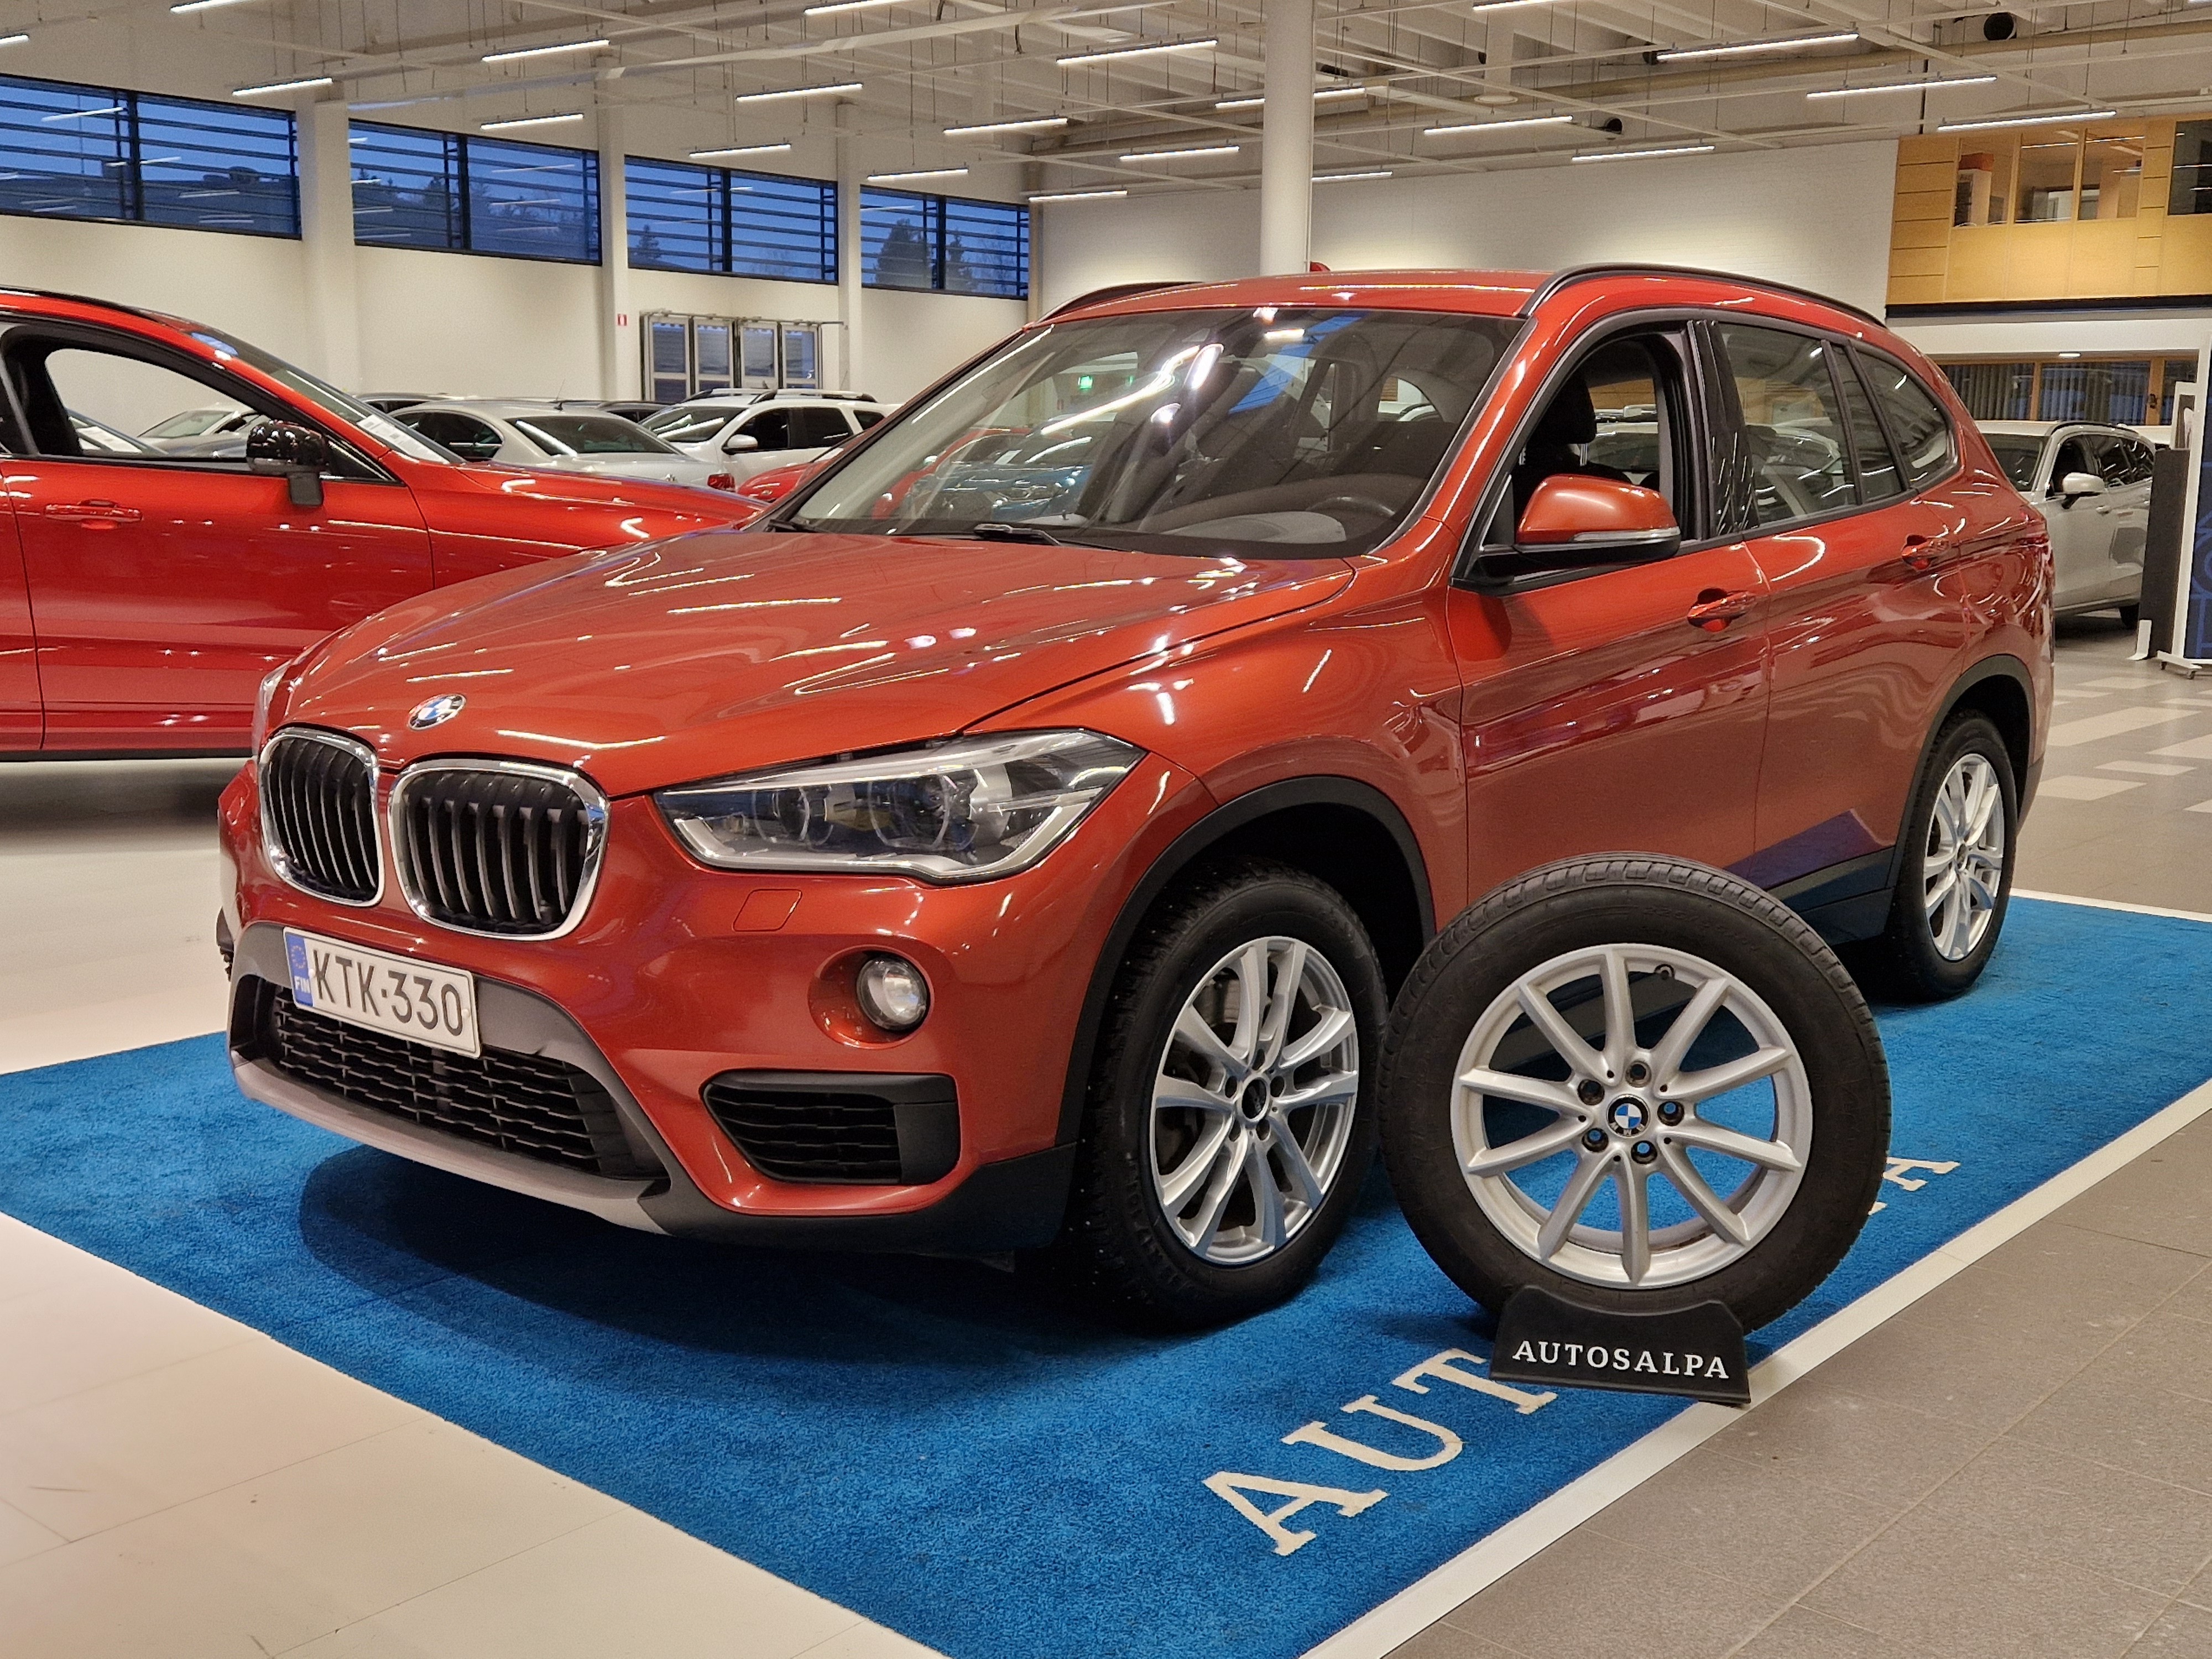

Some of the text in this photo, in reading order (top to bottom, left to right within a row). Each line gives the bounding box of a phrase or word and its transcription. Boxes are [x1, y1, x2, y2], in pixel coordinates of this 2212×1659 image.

[294, 975, 311, 994] FIN
[312, 950, 463, 1036] KTK-330
[1512, 1340, 1729, 1379] AUTOSALPA
